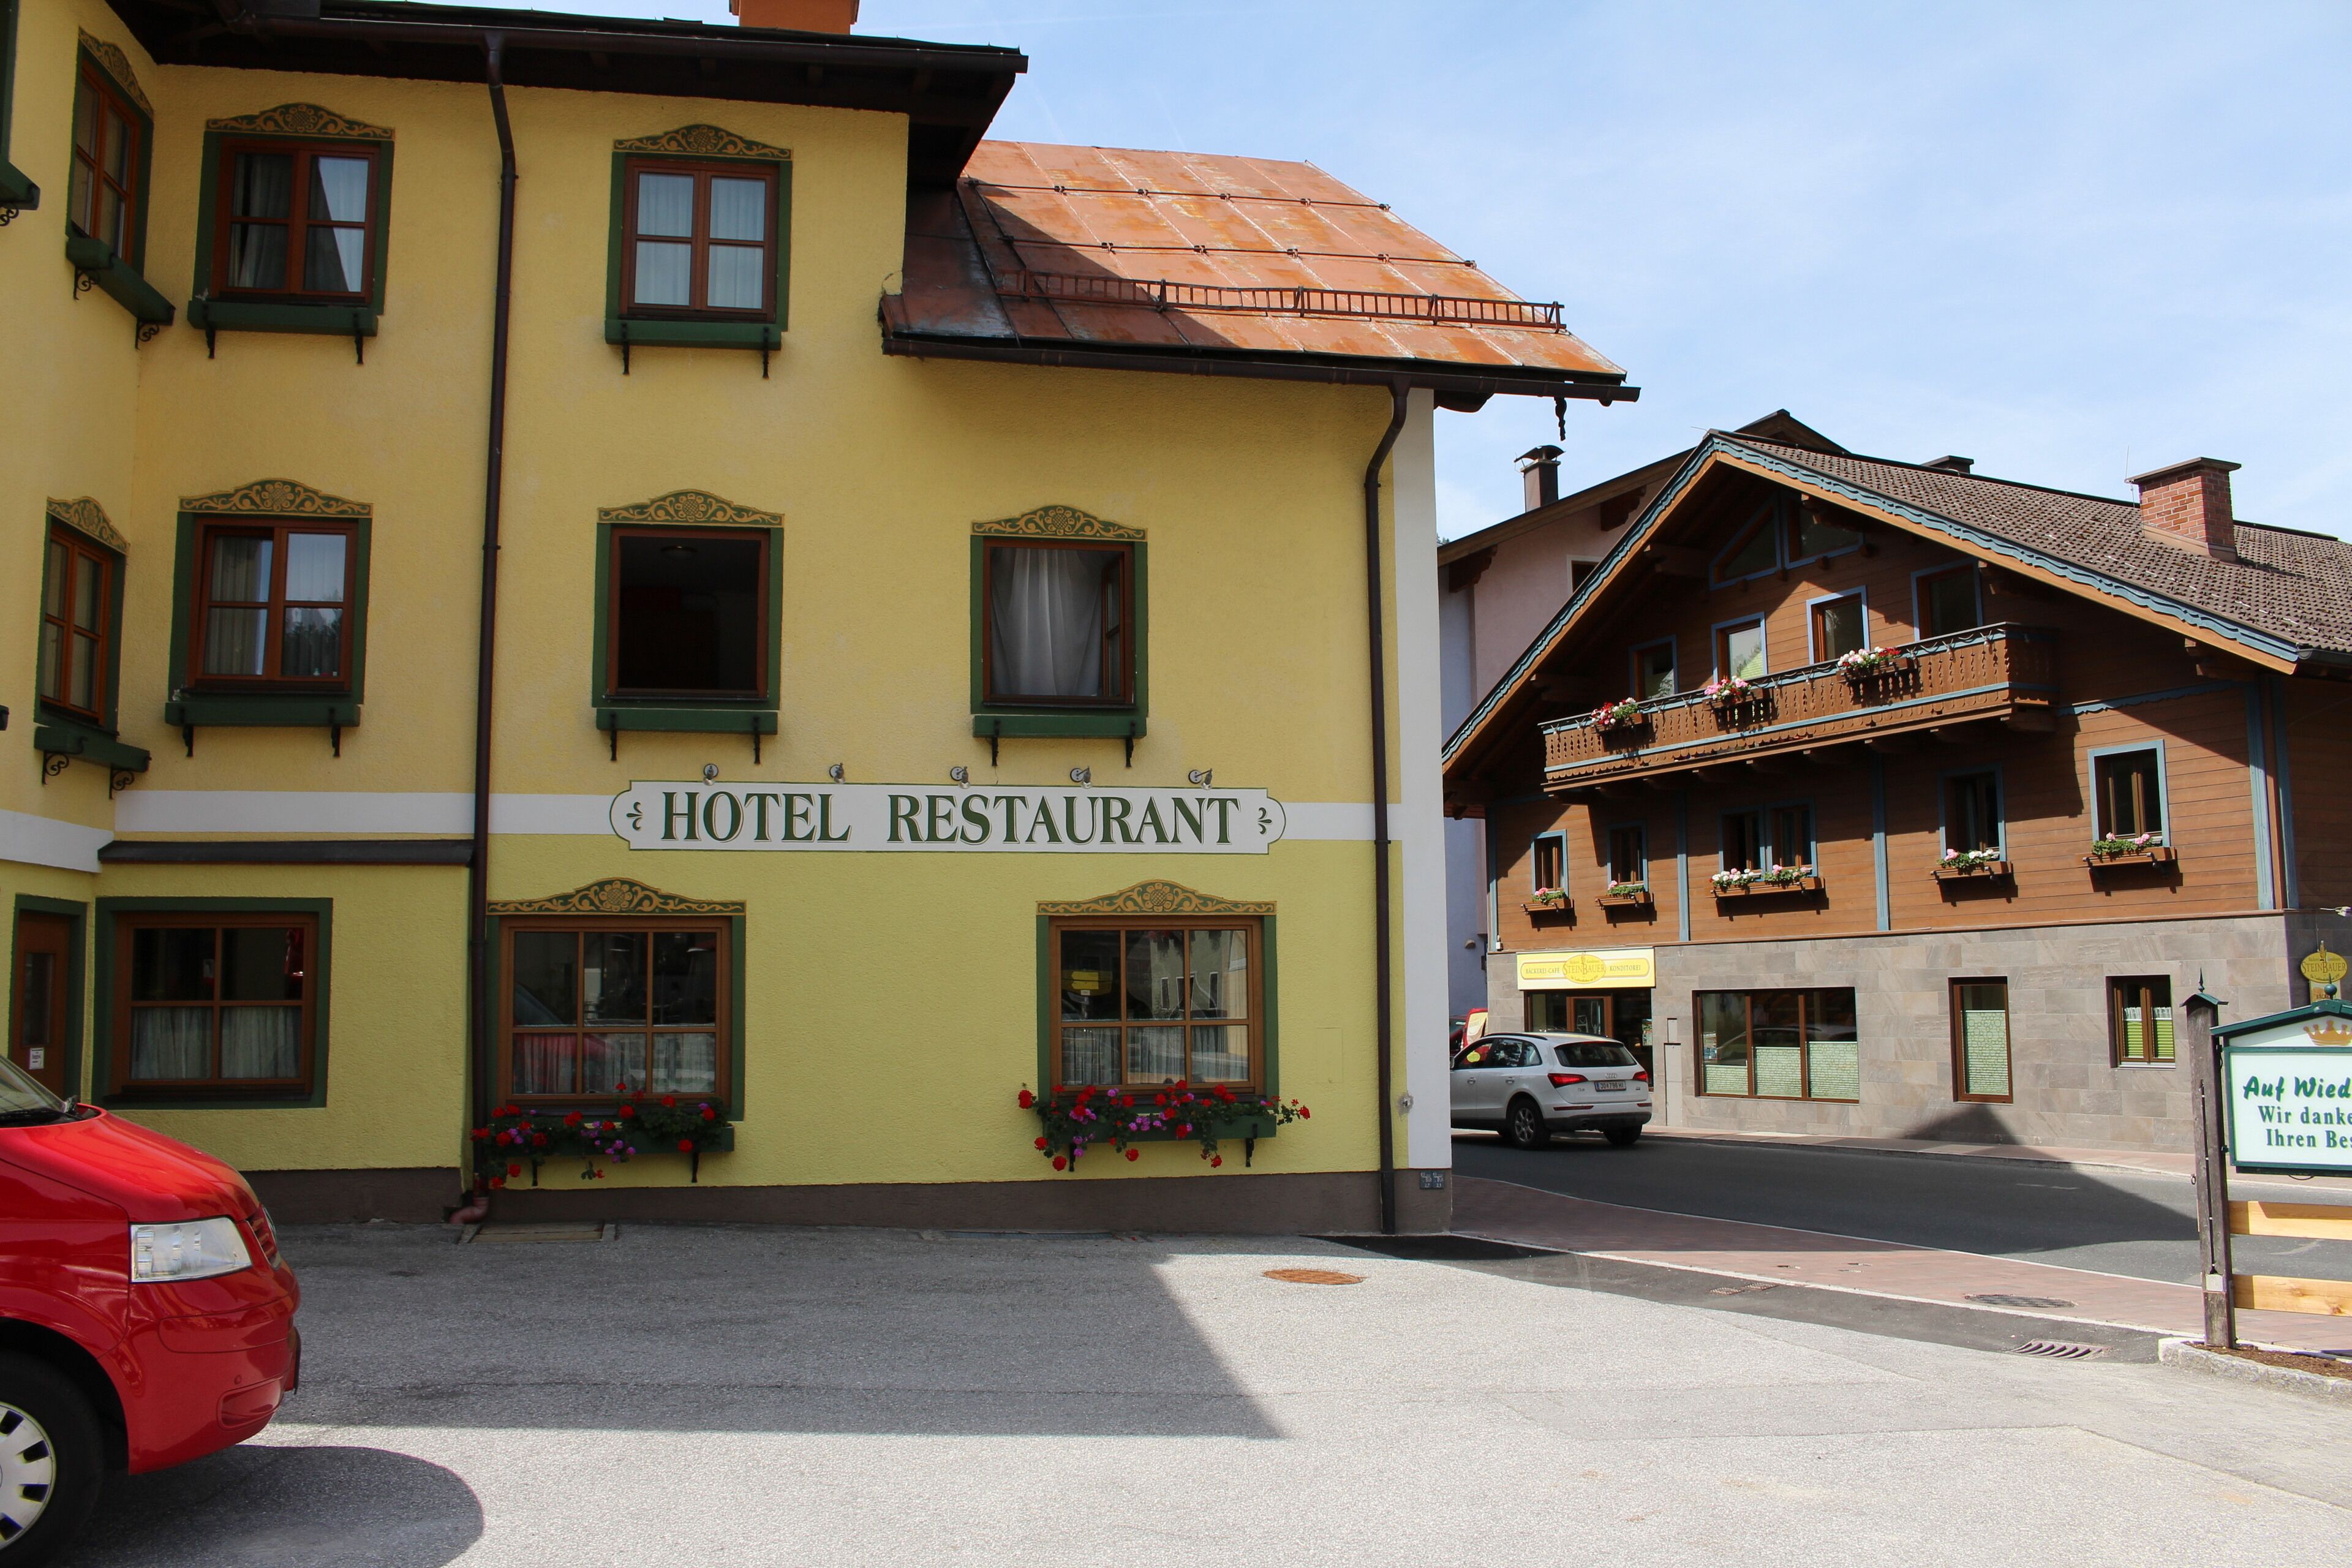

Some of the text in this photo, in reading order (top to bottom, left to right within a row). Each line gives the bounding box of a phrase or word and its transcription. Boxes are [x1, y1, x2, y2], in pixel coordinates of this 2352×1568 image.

[662, 791, 1241, 845] HOTEL RESTAURANT
[2242, 1076, 2351, 1102] Auf Wied
[2258, 1106, 2352, 1125] Wir danke
[2266, 1128, 2316, 1147] Ihren
